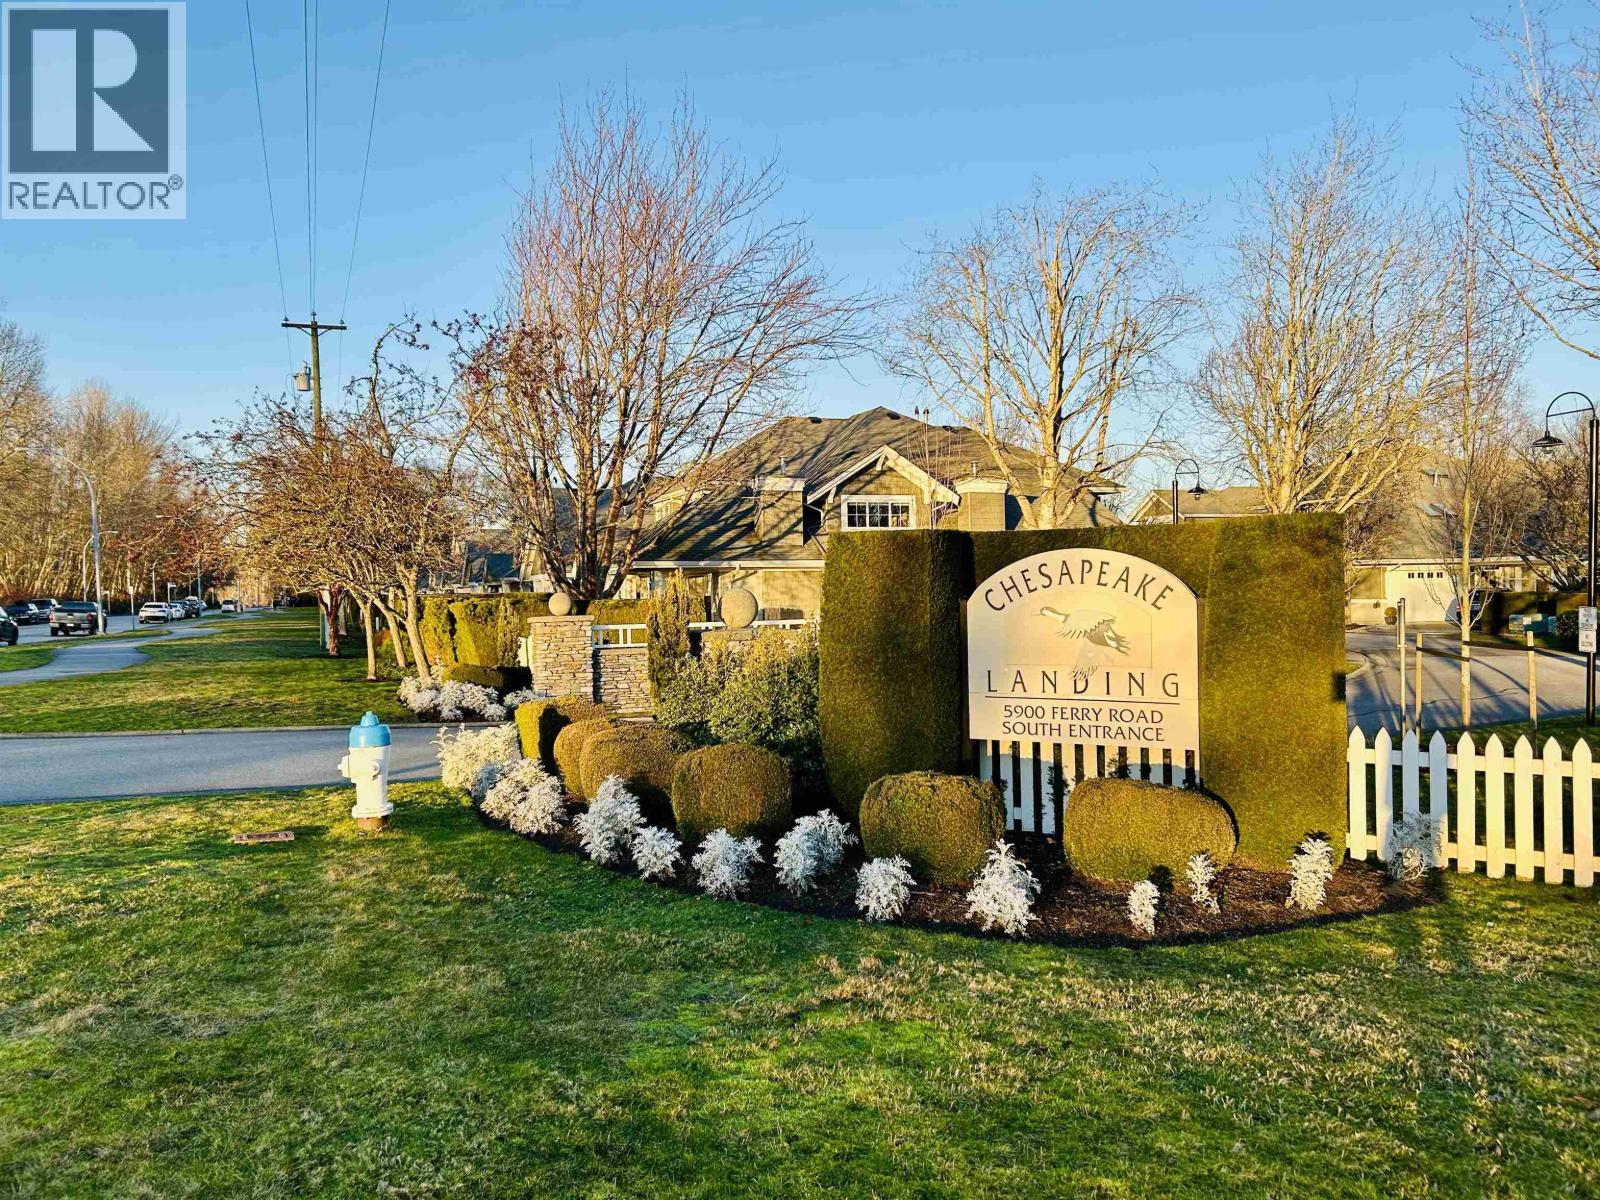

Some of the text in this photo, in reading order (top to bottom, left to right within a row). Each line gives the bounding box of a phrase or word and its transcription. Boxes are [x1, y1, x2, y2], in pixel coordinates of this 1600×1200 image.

[984, 559, 1174, 611] CHESAPEAKE
[987, 670, 1180, 698] LANDING
[1003, 704, 1164, 724] 5900 FERRY ROAD
[1002, 721, 1166, 742] SOUTH ENTRANCE
